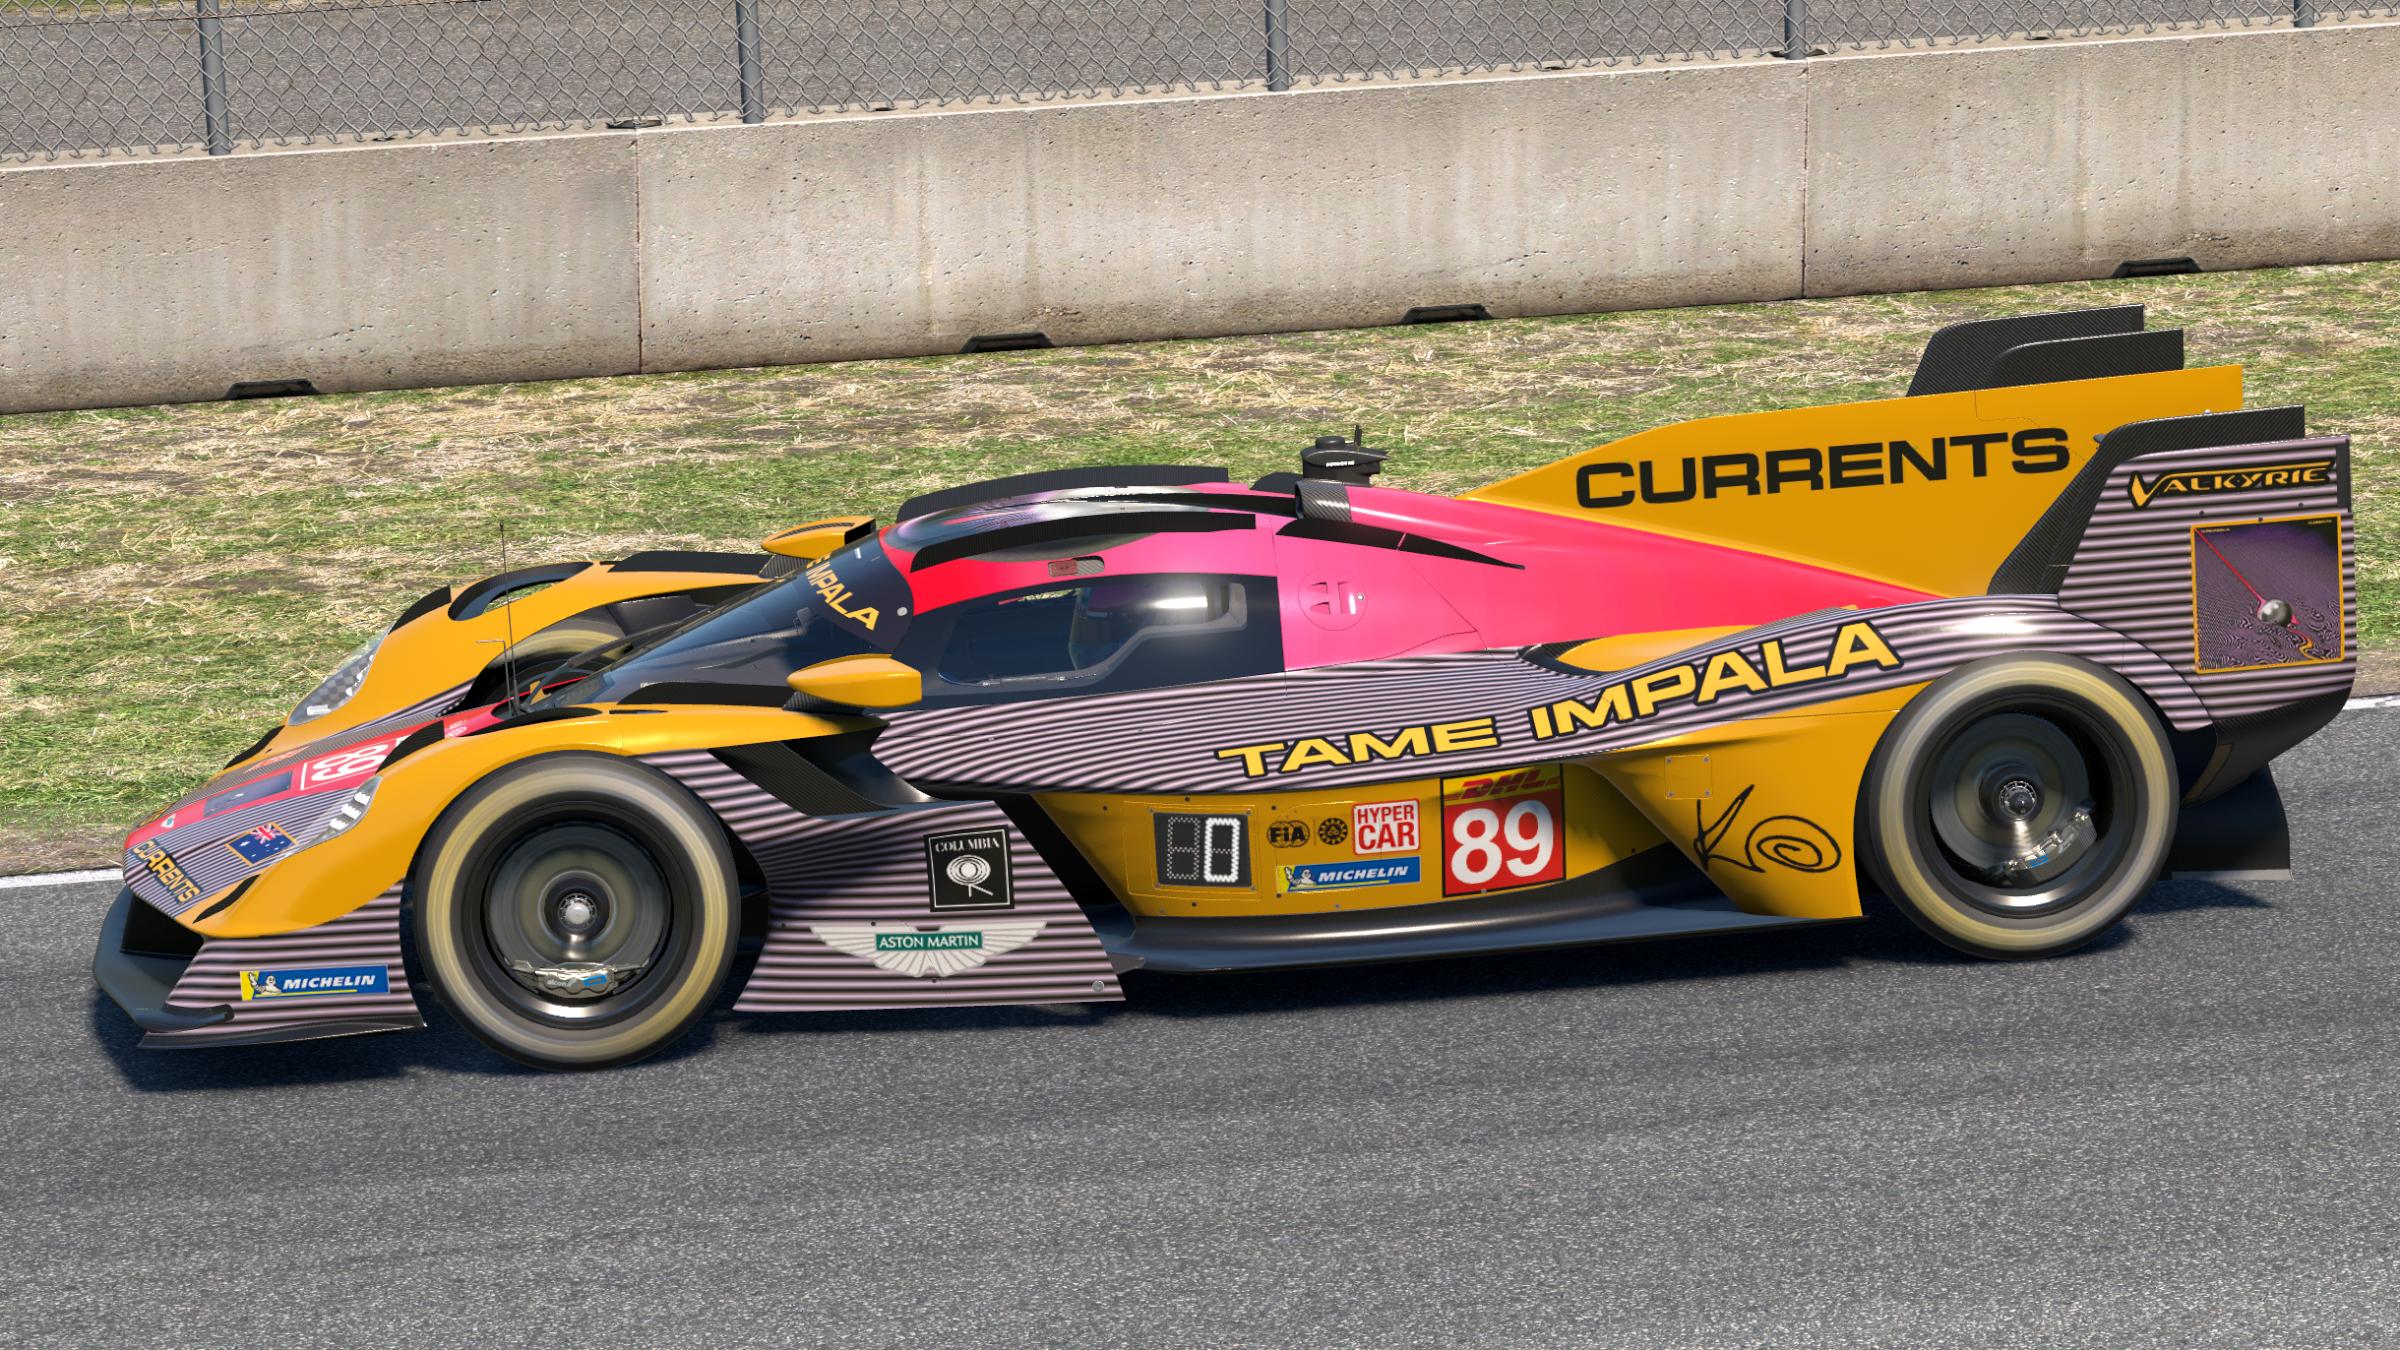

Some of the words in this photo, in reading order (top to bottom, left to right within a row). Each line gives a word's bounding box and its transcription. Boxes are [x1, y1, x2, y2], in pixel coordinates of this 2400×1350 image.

[1575, 427, 2070, 509] CURRENTS
[2131, 460, 2332, 507] VALKYRIE
[1217, 716, 1499, 778] TAME
[1529, 622, 1898, 740] IMPALA
[1460, 769, 1547, 799] DHL
[1357, 804, 1415, 825] HYPER
[935, 837, 1000, 853] COLUMBIA
[1357, 821, 1416, 851] CAR
[1451, 800, 1554, 884] 89
[133, 840, 201, 903] CURRENTS
[1317, 865, 1409, 882] MICHELIN
[879, 936, 924, 949] ASTON
[927, 935, 979, 947] MARTIN
[283, 975, 376, 990] MICHELIN
